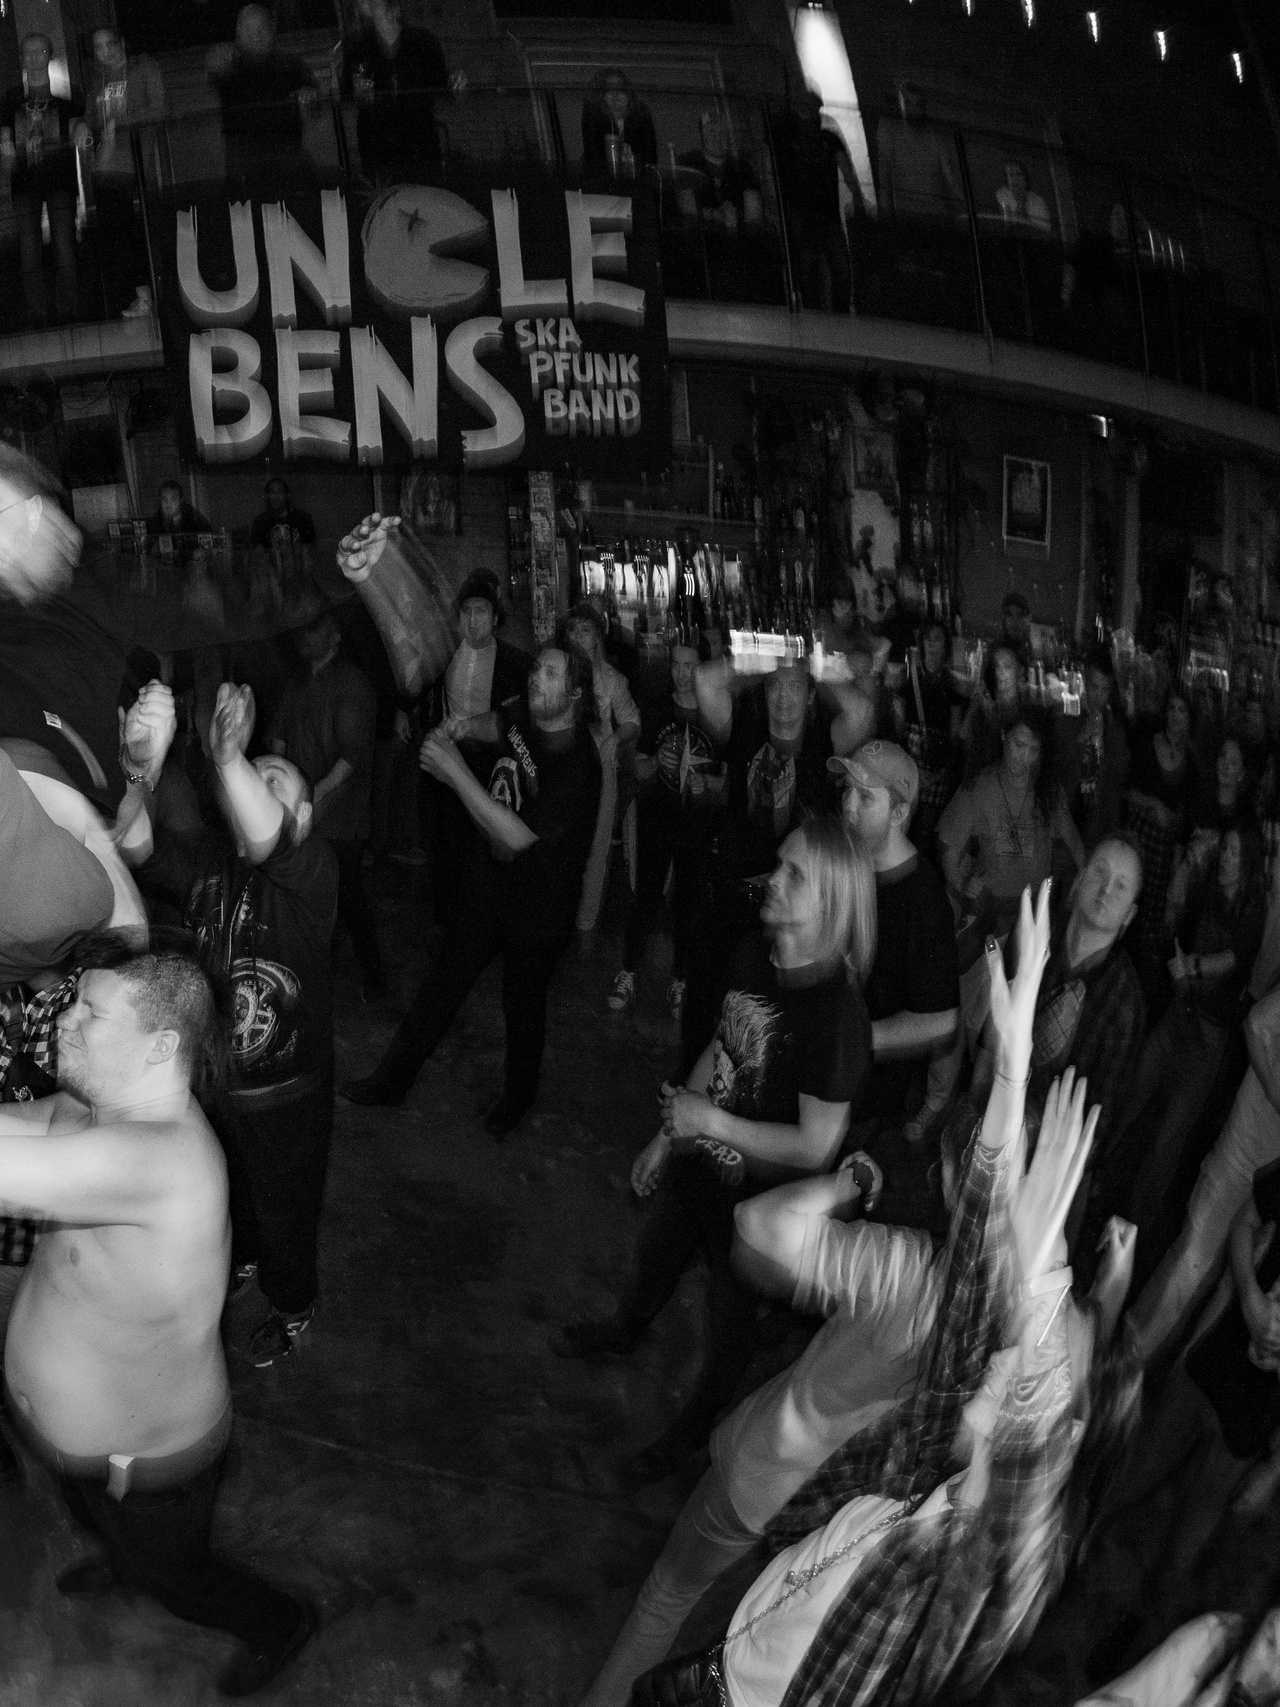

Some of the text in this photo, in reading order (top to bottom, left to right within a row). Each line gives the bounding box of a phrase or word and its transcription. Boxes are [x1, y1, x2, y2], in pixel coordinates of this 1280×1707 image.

[514, 317, 581, 350] SKA
[189, 314, 524, 467] BENS
[529, 351, 640, 391] PFUNK
[543, 388, 641, 430] BAND
